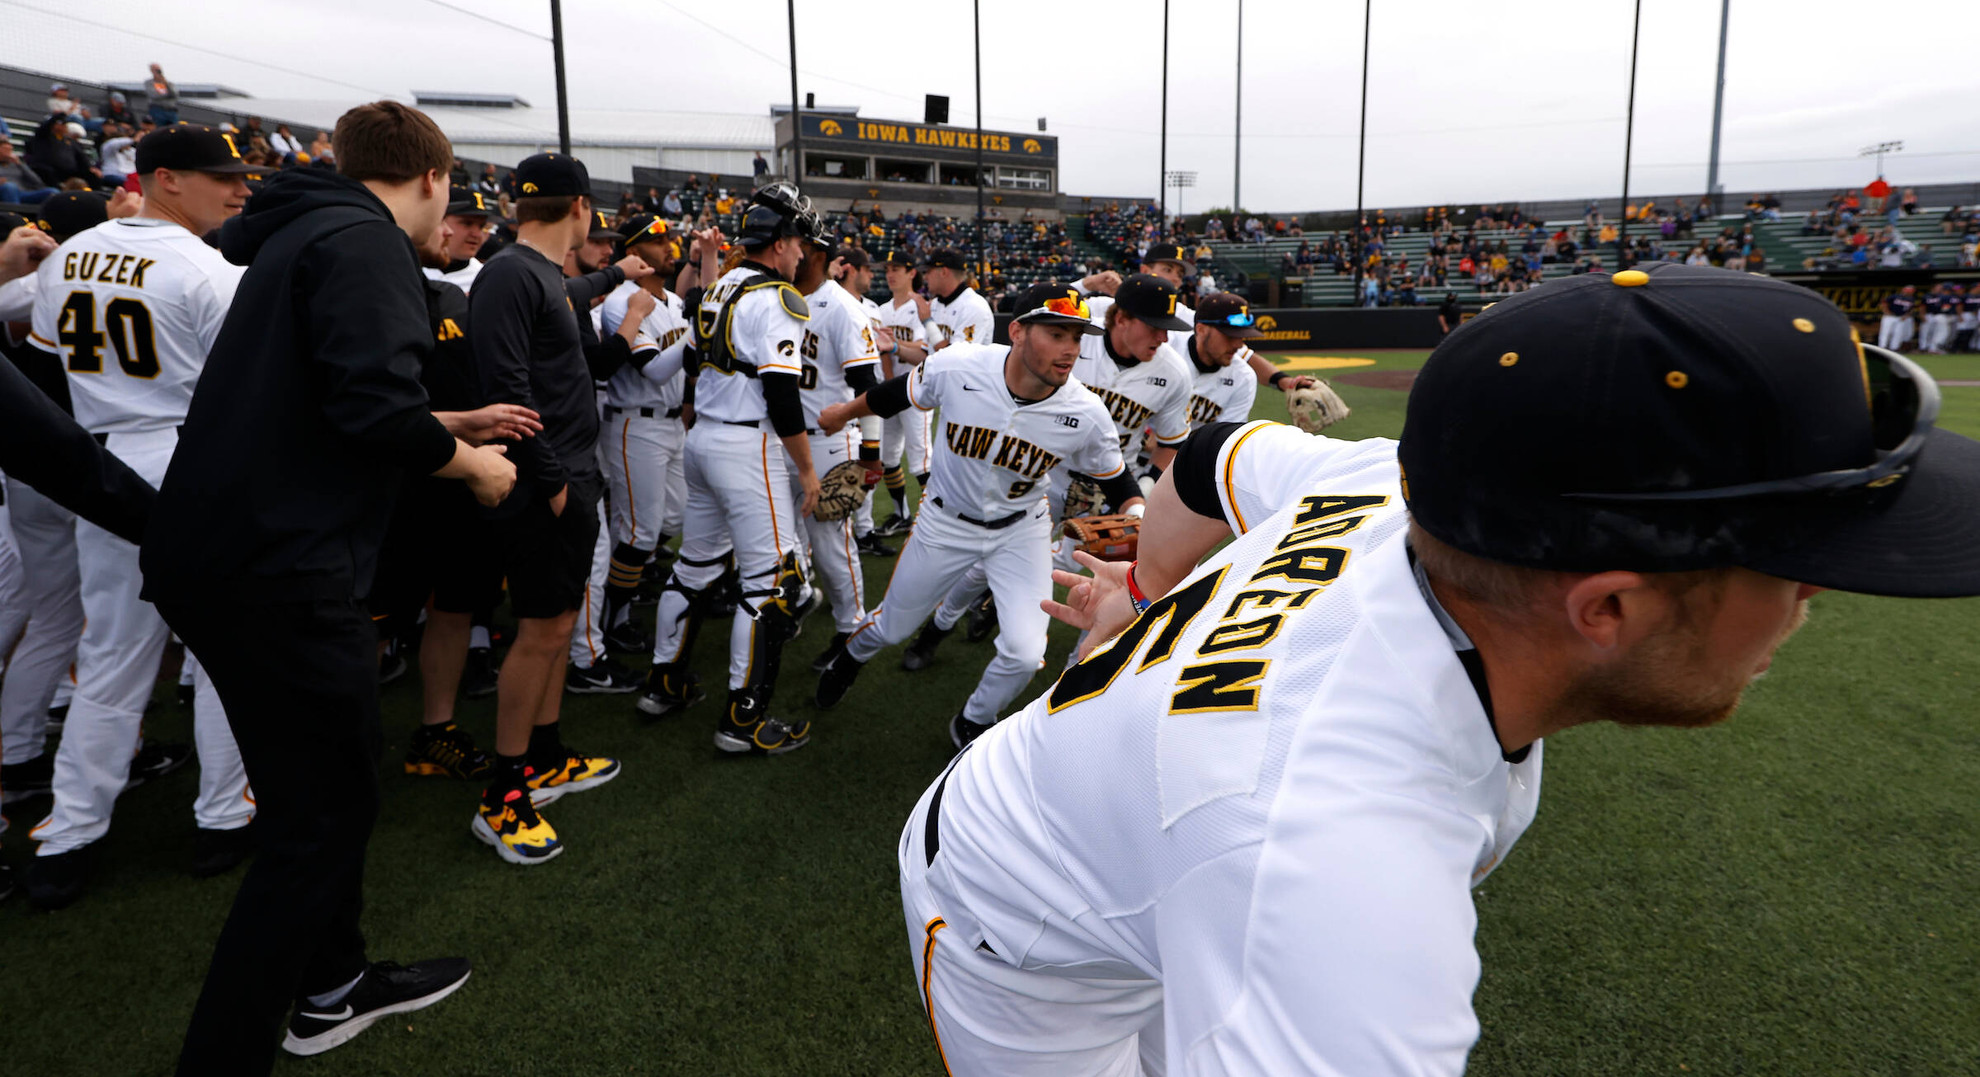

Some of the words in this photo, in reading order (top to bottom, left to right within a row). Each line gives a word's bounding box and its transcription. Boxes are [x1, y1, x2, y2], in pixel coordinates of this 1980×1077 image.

[858, 122, 909, 143] IOWA
[915, 128, 1011, 152] HAWKEYES
[64, 252, 156, 288] GUZEK
[57, 290, 162, 380] 40
[1168, 494, 1392, 716] ADREON
